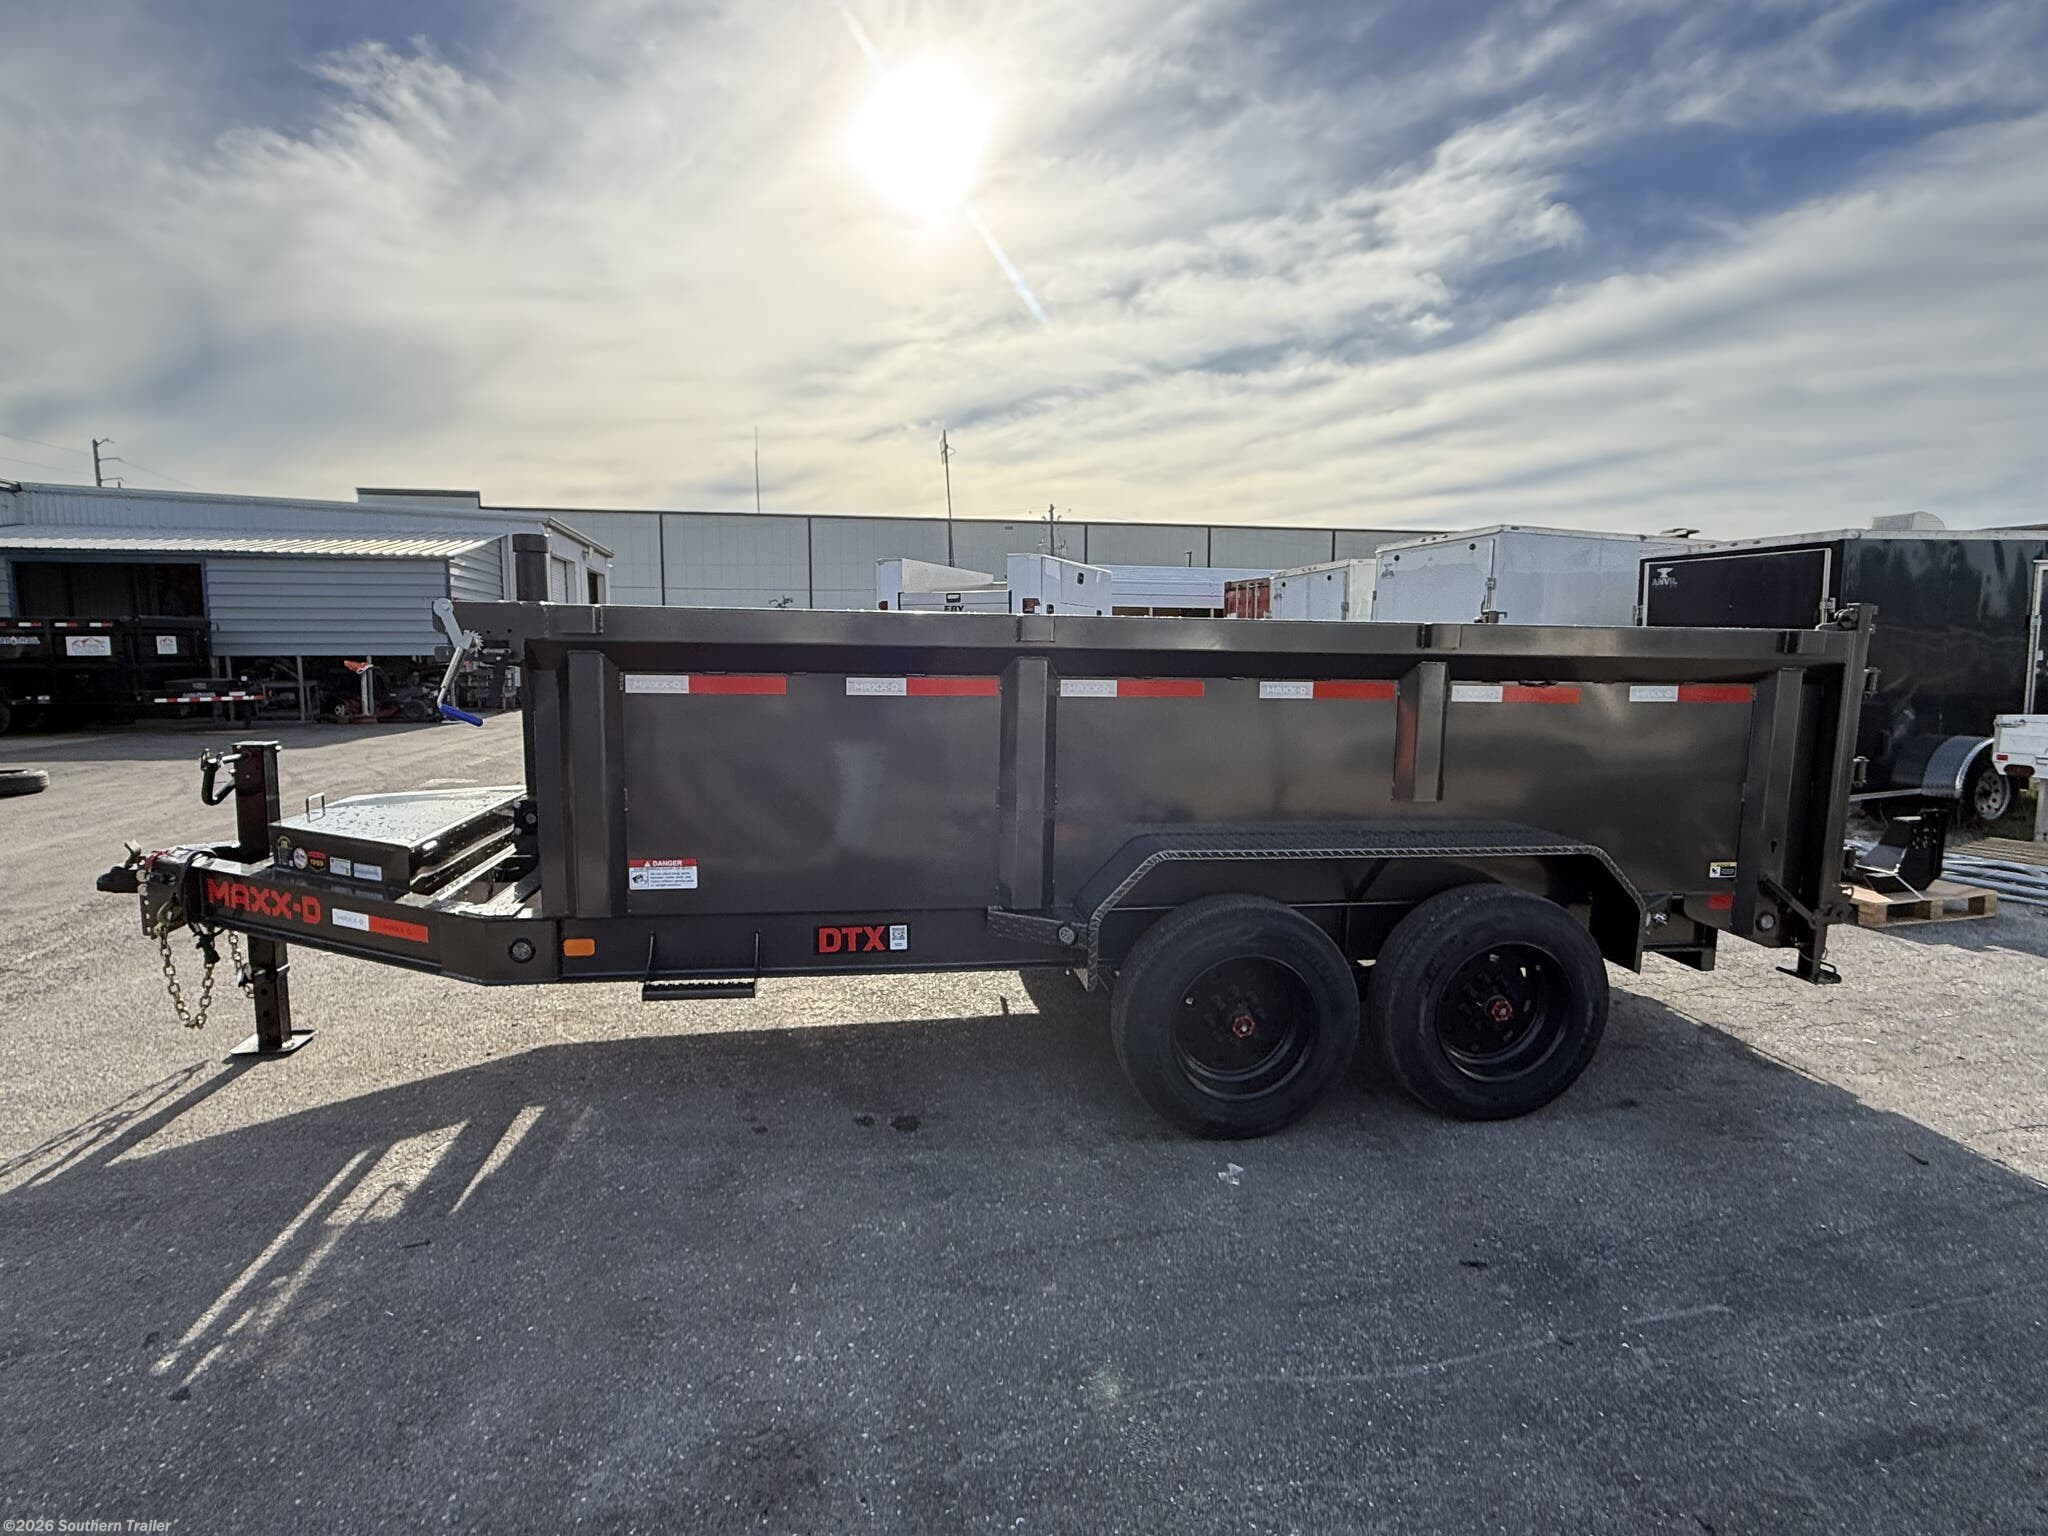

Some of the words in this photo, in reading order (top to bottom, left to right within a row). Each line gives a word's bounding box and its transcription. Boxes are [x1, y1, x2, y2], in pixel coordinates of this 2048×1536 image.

[1651, 577, 1678, 586] ANVIL
[207, 878, 321, 925] MAXX-D
[818, 925, 886, 953] DTX
